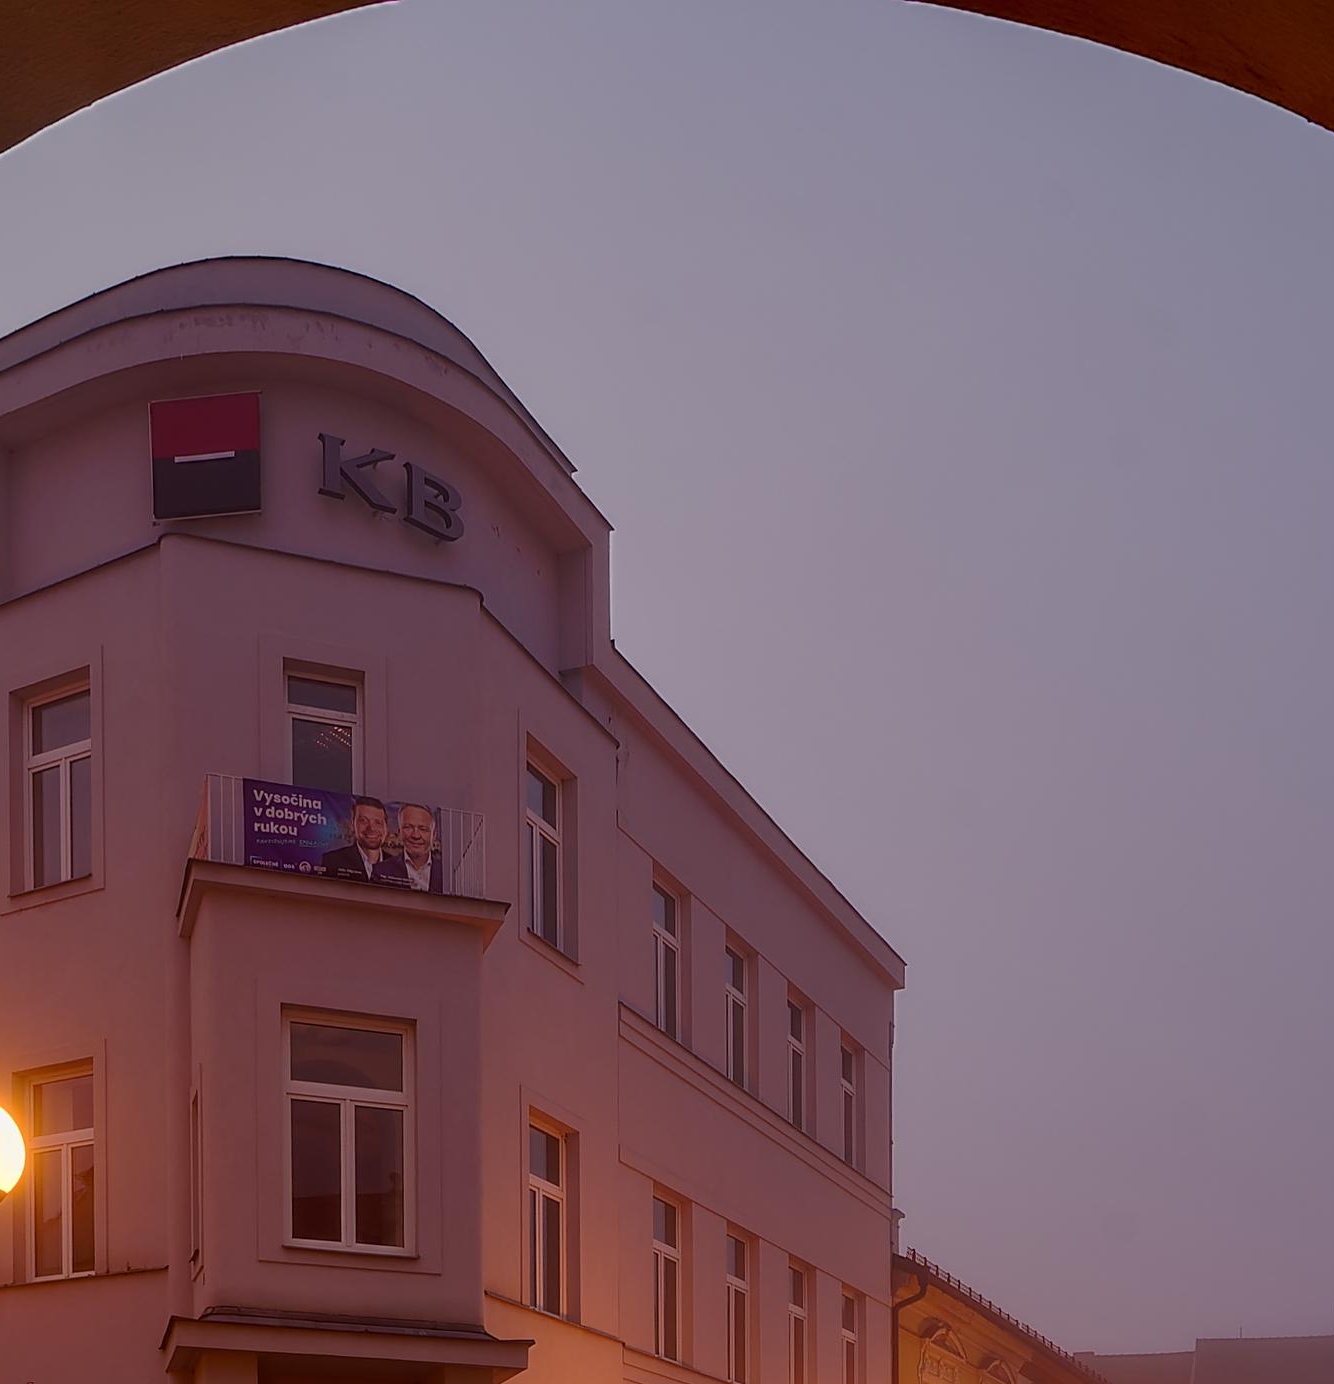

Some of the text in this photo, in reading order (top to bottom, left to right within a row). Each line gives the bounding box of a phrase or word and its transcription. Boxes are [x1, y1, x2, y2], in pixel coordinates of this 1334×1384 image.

[317, 432, 465, 542] KB
[252, 789, 322, 810] Vysočina
[254, 807, 327, 826] v dobrých
[254, 822, 298, 837] rukou
